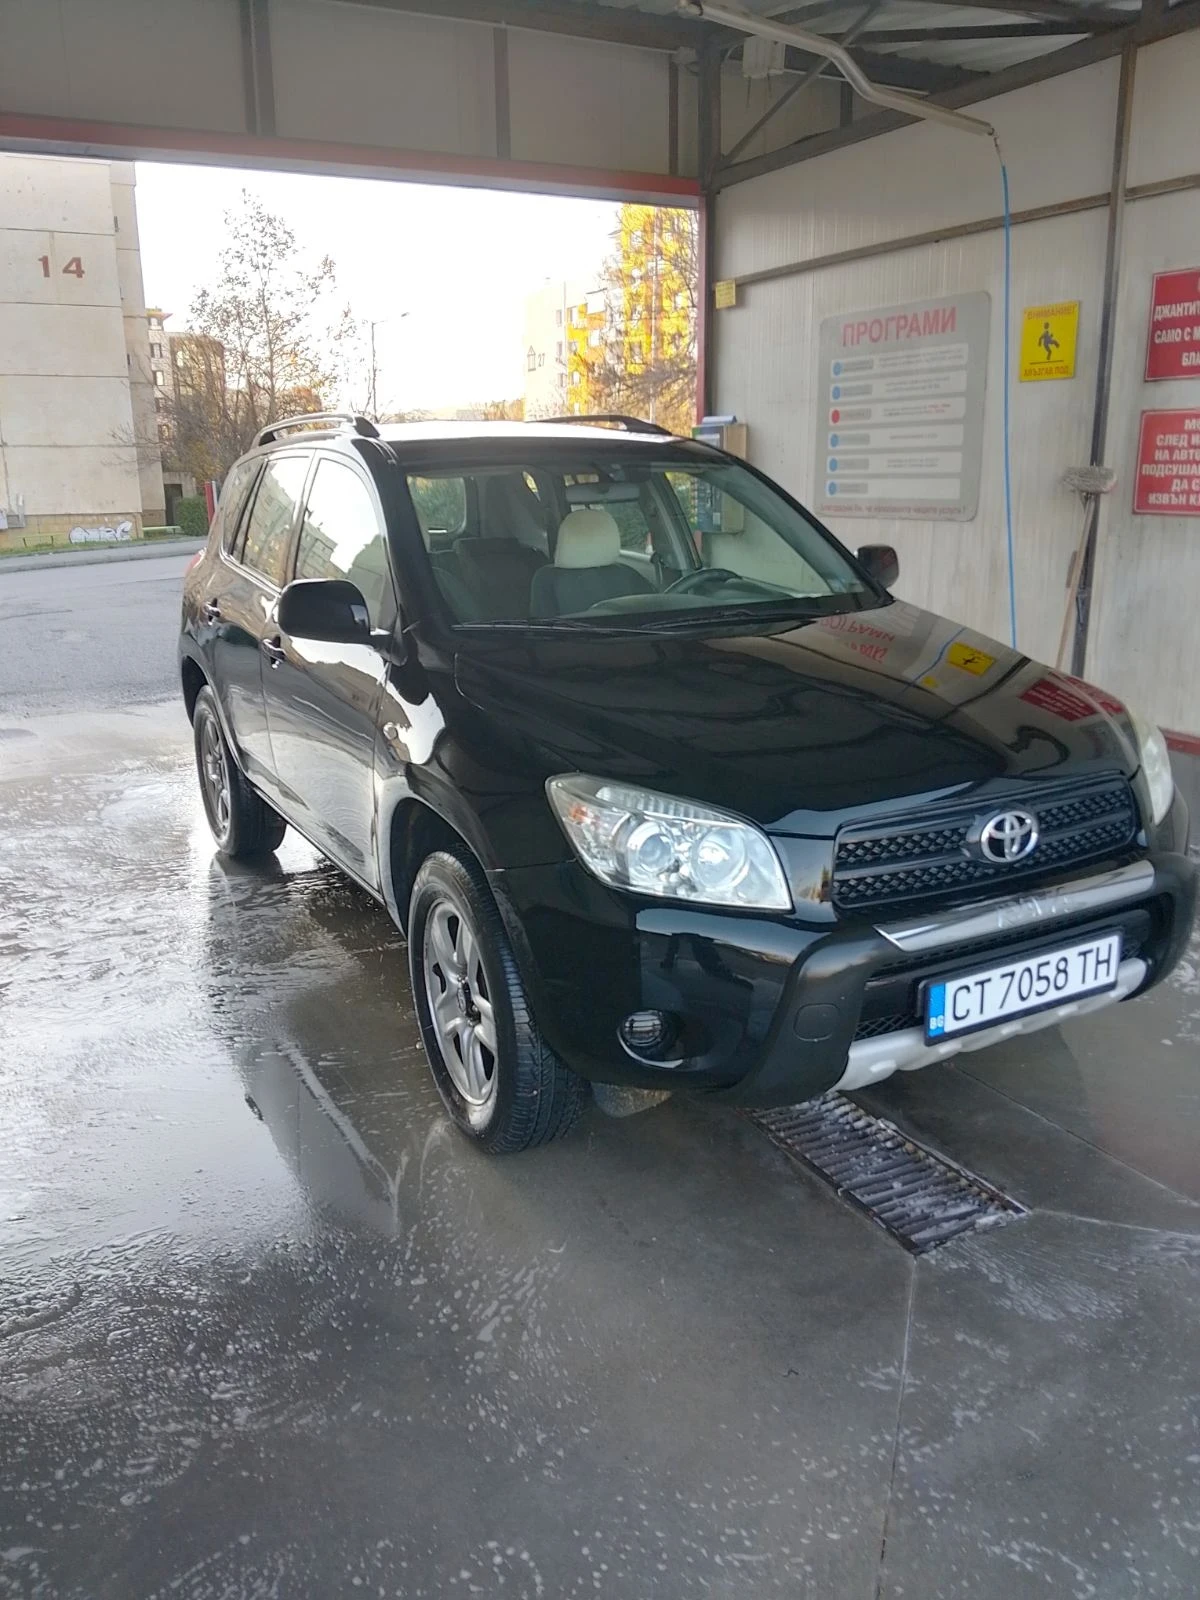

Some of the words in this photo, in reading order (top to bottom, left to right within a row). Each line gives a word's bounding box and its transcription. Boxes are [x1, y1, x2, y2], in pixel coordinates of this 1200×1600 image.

[38, 255, 86, 279] 14
[842, 306, 957, 348] ПРОГРАМИ
[1154, 328, 1182, 344] САМО
[1183, 327, 1192, 341] С
[1157, 434, 1187, 448] СЛЕД
[1155, 449, 1170, 461] НА
[1171, 479, 1189, 492] ДА
[1148, 493, 1187, 506] ИЗВЪН
[998, 956, 1069, 1010] 7058
[929, 1014, 945, 1030] BG
